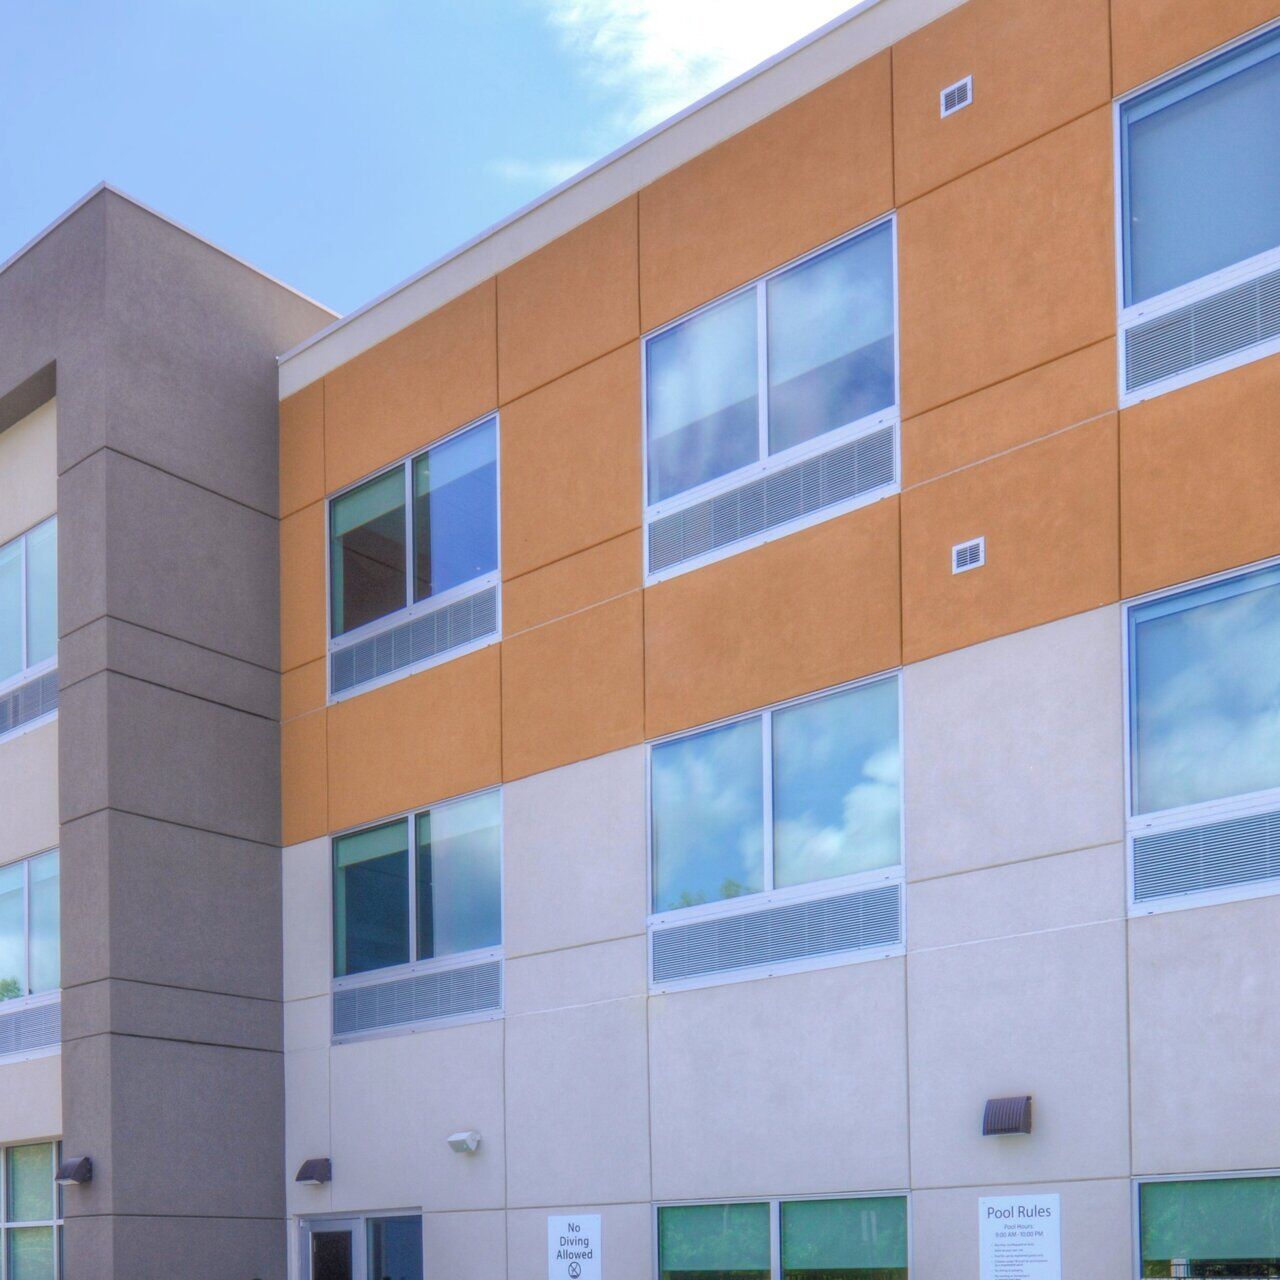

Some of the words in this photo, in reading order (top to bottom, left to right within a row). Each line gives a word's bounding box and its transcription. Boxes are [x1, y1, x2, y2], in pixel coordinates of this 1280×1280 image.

[987, 1205, 1014, 1219] Pool
[1018, 1204, 1051, 1218] Rules
[567, 1222, 581, 1233] No
[560, 1236, 590, 1248] Diving
[557, 1249, 593, 1260] Allowed
